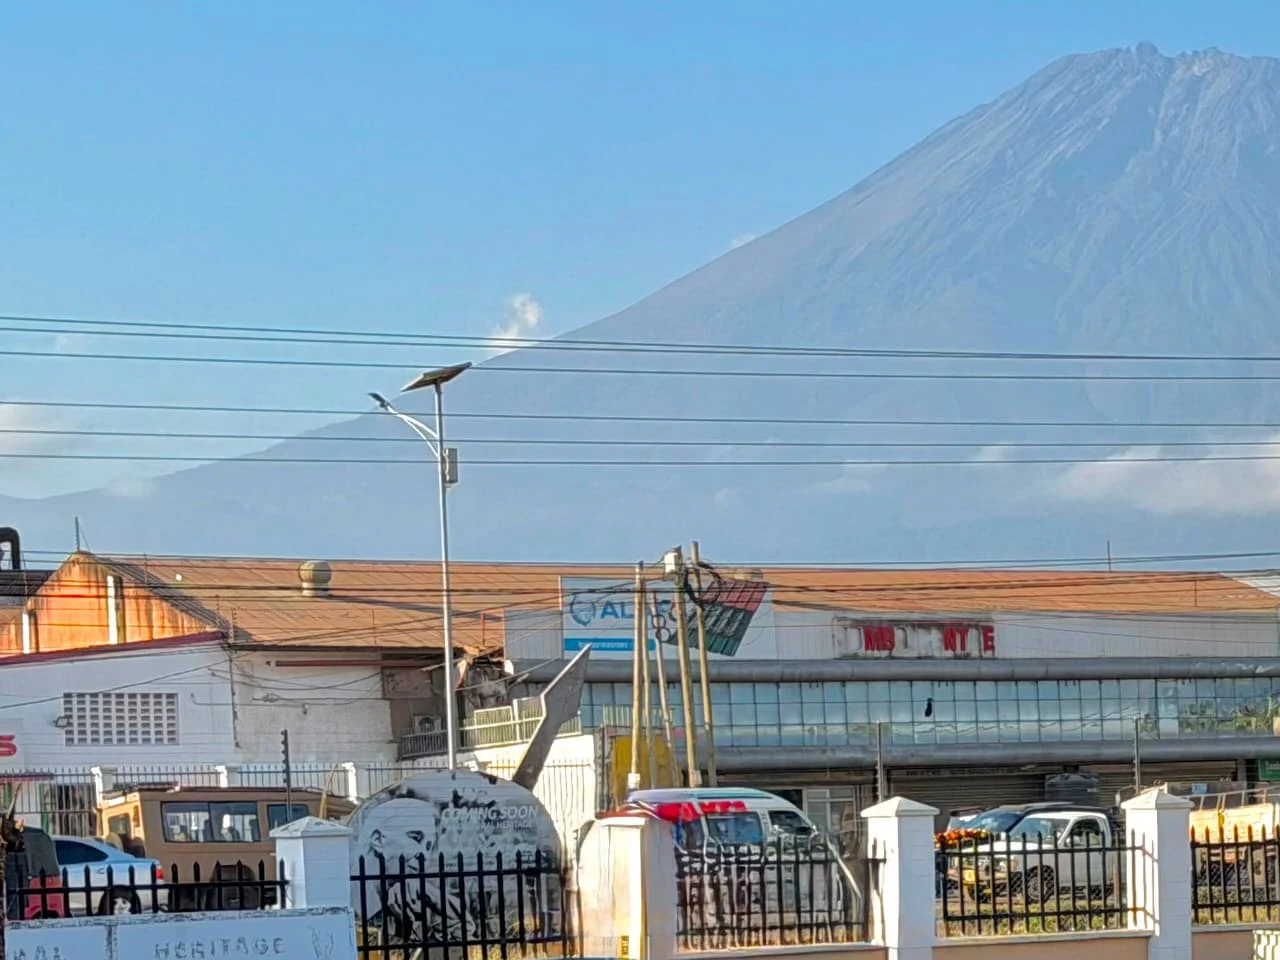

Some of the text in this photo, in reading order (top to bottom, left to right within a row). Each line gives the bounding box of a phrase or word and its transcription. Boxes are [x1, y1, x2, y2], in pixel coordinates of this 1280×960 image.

[442, 804, 539, 821] COMING SOON
[154, 936, 285, 959] HERITAGE
